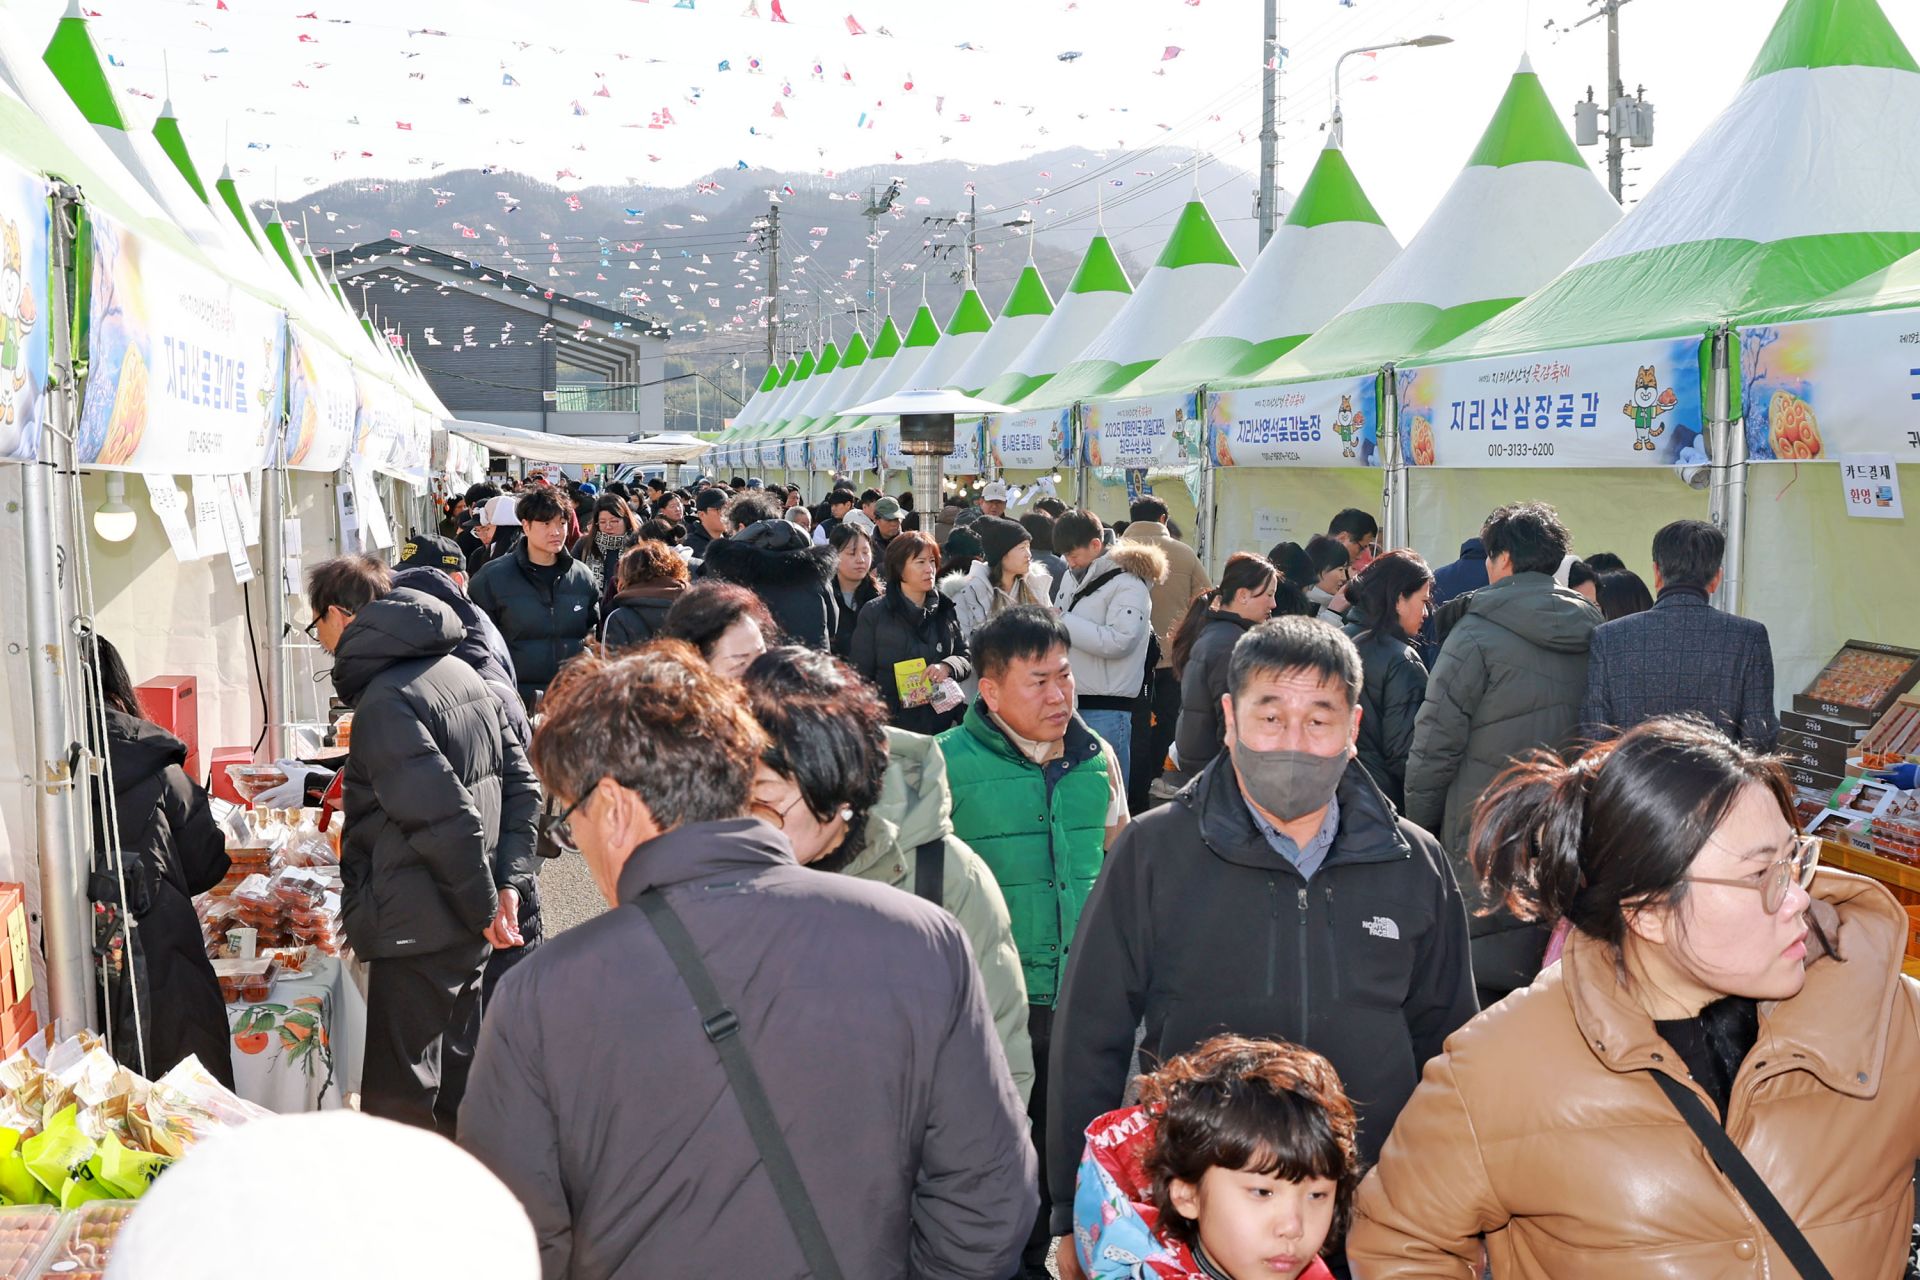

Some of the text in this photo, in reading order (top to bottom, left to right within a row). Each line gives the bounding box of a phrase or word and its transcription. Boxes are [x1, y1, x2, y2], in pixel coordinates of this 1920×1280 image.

[1450, 391, 1600, 431] 지리산삼장곶감
[1104, 422, 1121, 438] 2025
[1237, 414, 1322, 444] 지리산영석곶감농장
[1488, 442, 1554, 457] 010-3133-6200
[1850, 487, 1872, 505] 환영
[1362, 920, 1387, 930] NORTH
[1372, 916, 1386, 924] THE
[1369, 927, 1387, 936] FACE
